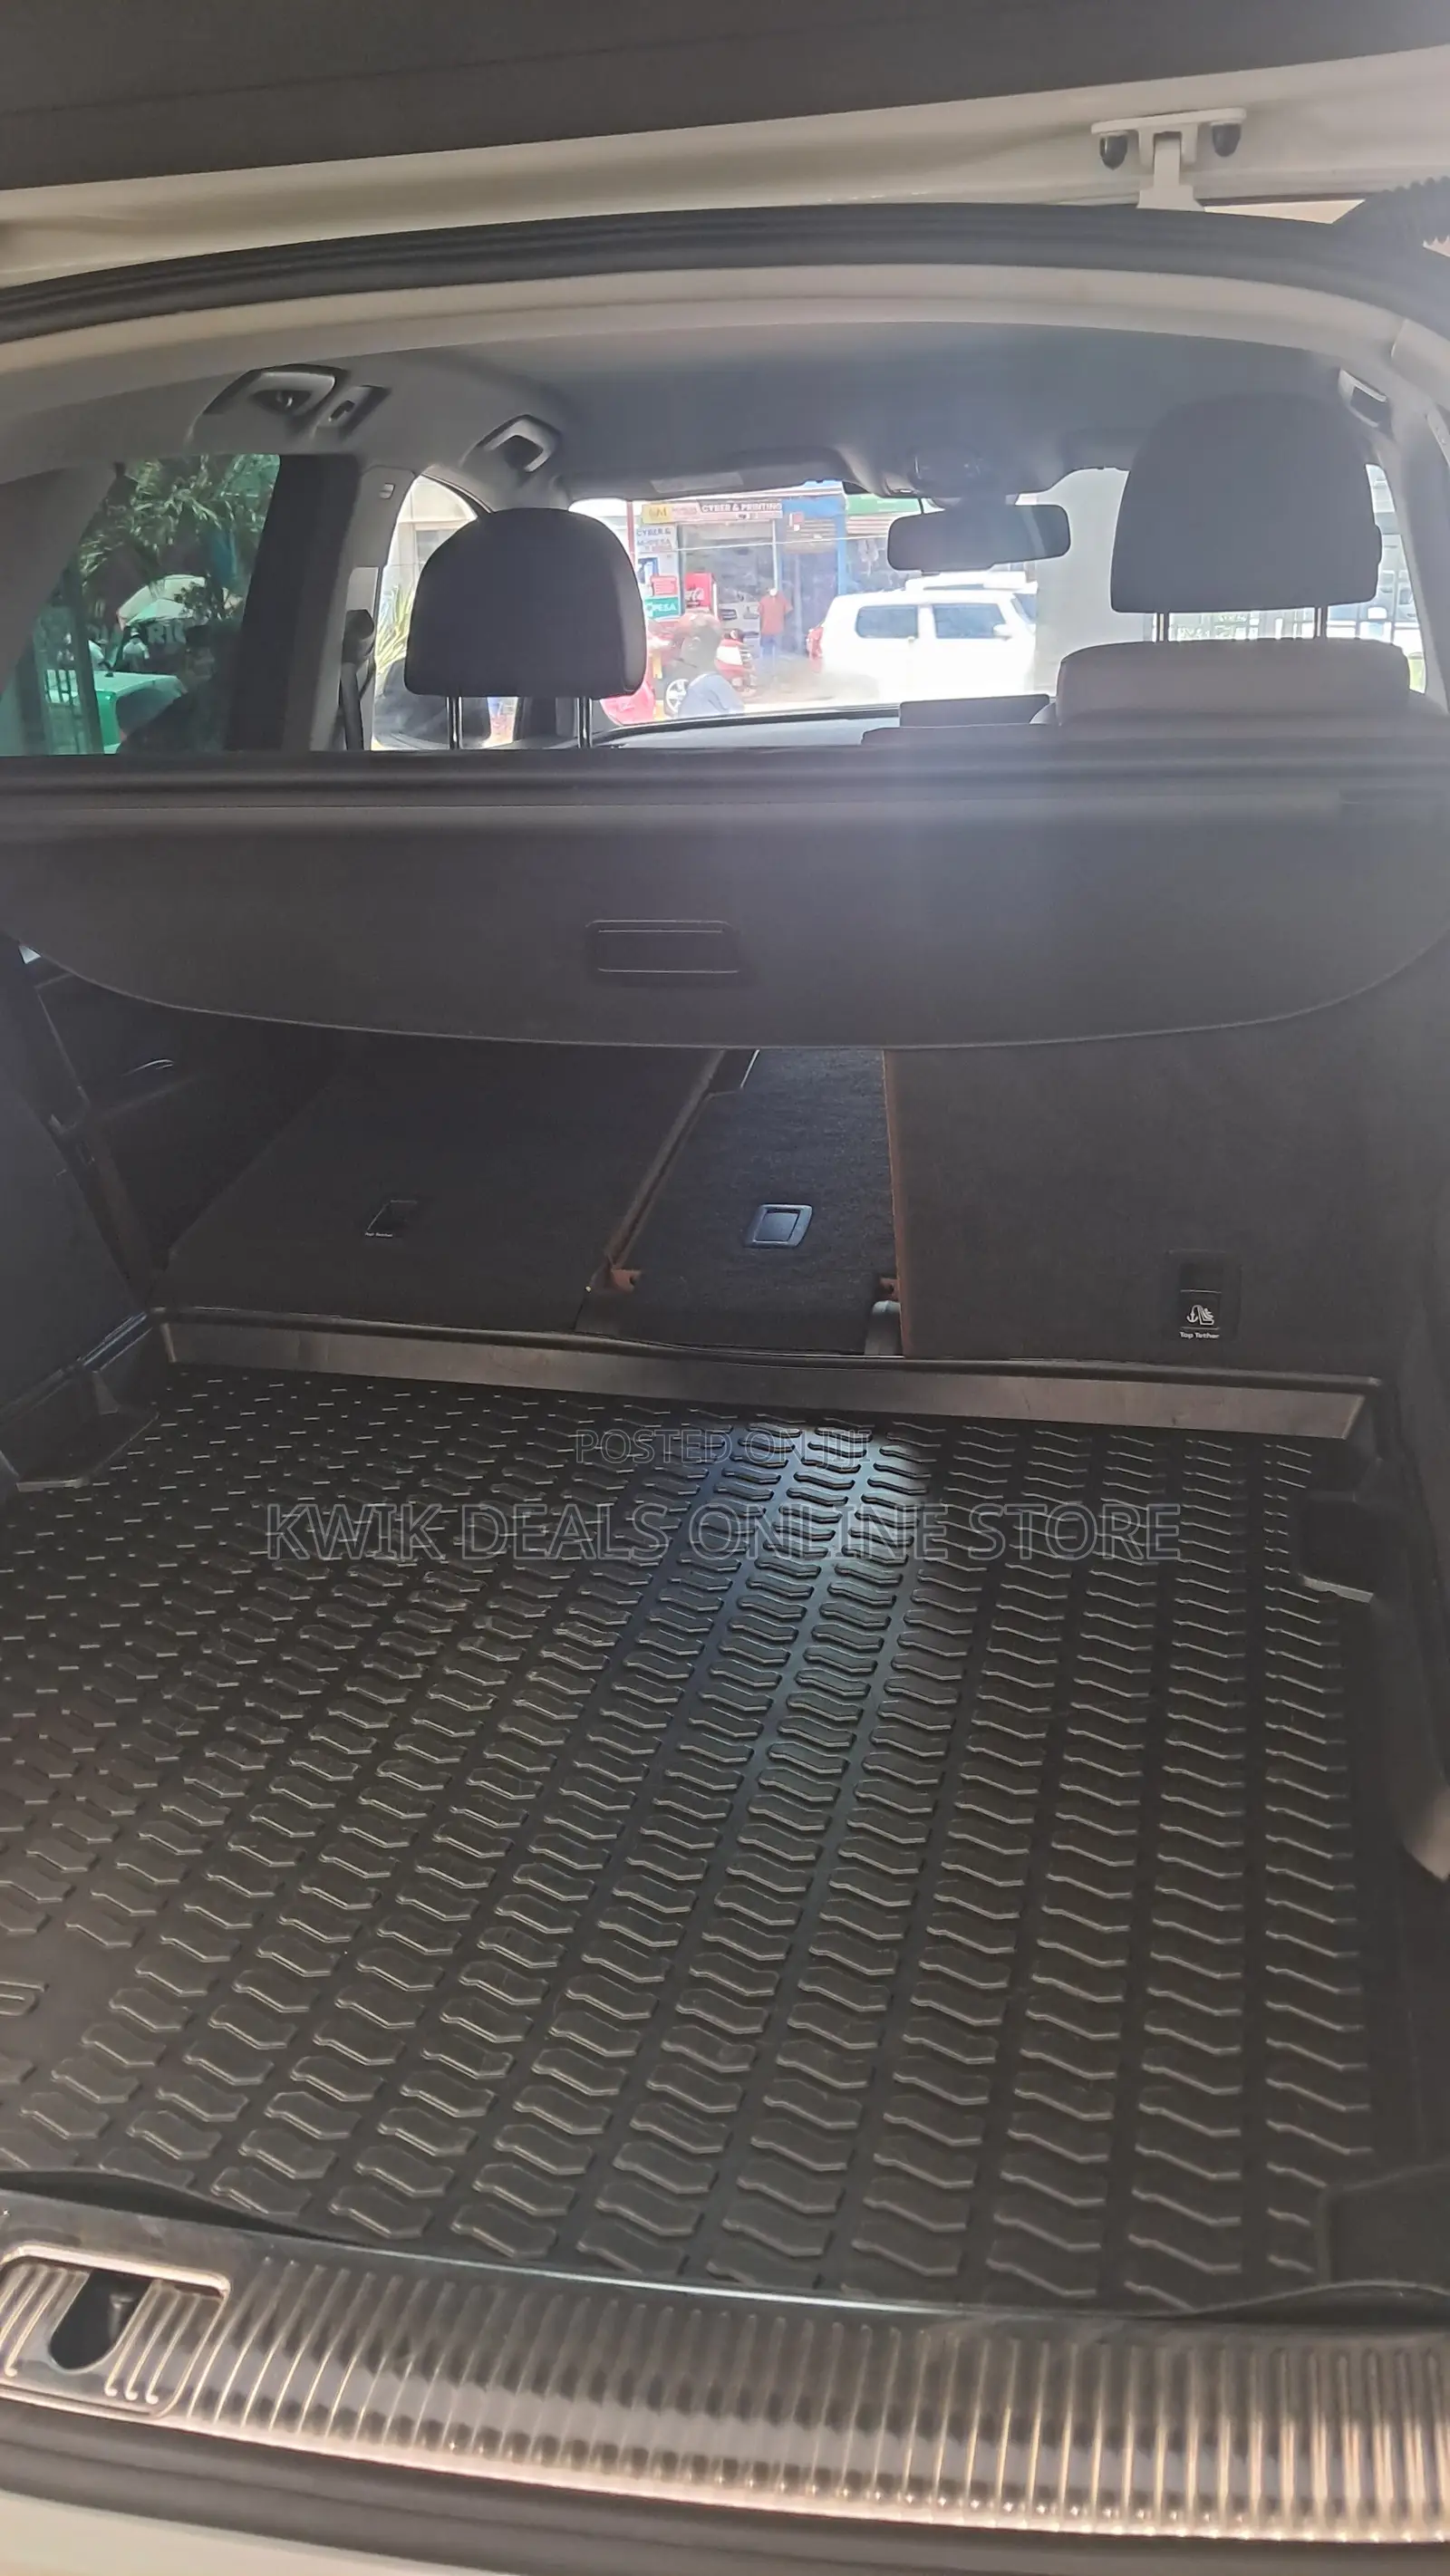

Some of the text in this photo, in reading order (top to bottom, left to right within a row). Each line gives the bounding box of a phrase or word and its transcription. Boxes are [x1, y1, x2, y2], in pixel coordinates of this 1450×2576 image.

[701, 504, 730, 513] CYBER
[732, 503, 740, 511] &
[1179, 1331, 1194, 1339] Top
